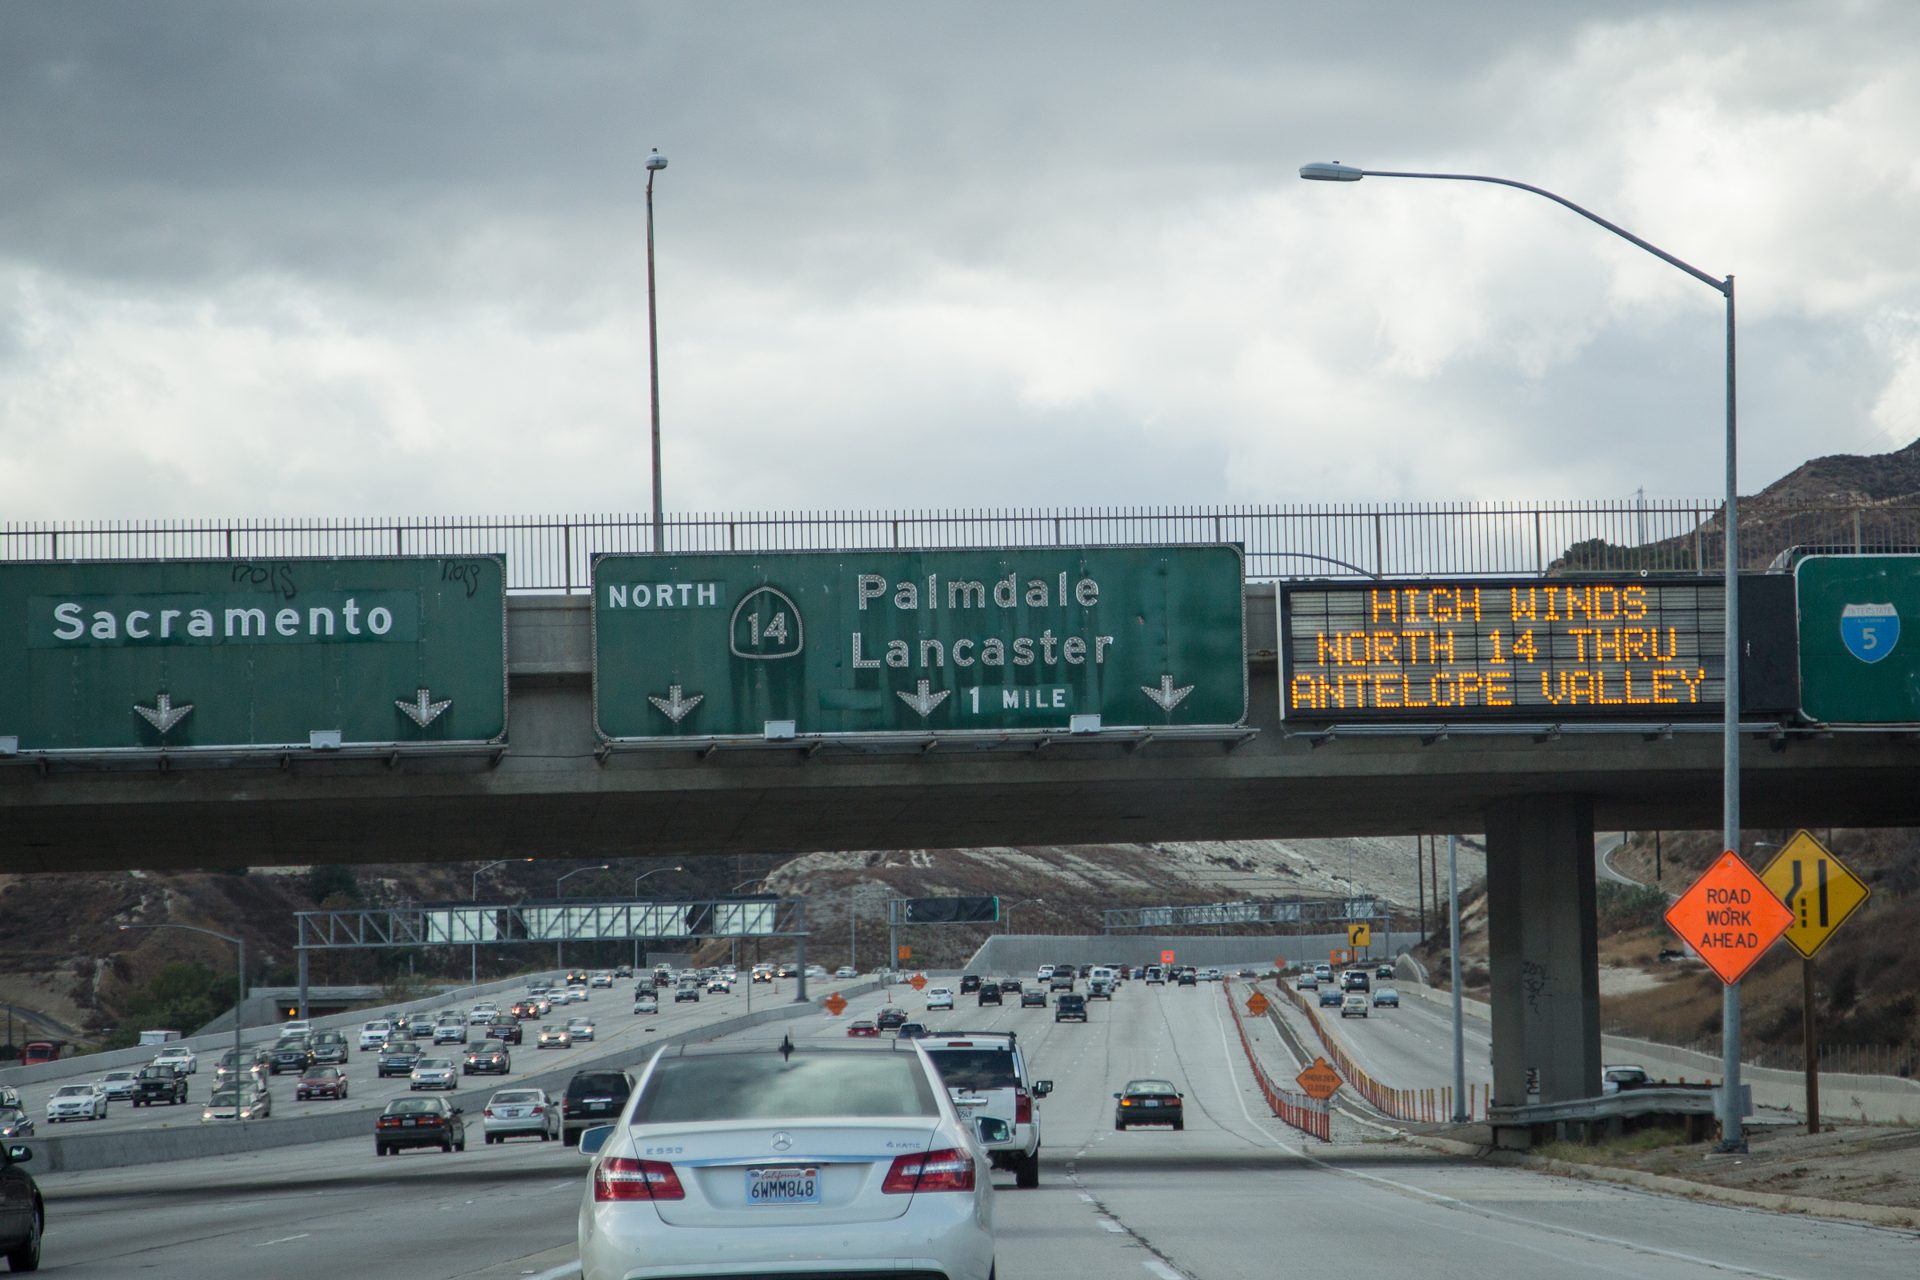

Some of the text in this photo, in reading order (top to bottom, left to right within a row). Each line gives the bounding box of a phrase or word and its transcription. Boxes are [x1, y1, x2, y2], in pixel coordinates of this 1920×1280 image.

[607, 583, 718, 609] NORTH
[858, 571, 1100, 611] Palmdale
[1371, 585, 1648, 625] HIGH WINDS
[52, 597, 393, 641] Sacramento
[746, 612, 788, 646] 14
[852, 628, 1114, 670] Lancaster
[1317, 626, 1678, 667] NORTH 14 THRU
[1862, 627, 1878, 651] 5
[969, 685, 1067, 715] 1 MILE
[1291, 666, 1706, 710] ANTELOPE VALLEY
[1707, 888, 1751, 904] ROAD
[1707, 910, 1751, 926] WORK
[1701, 933, 1758, 948] AHEAD
[751, 1180, 814, 1199] 6WMM848
[761, 1169, 801, 1181] California
